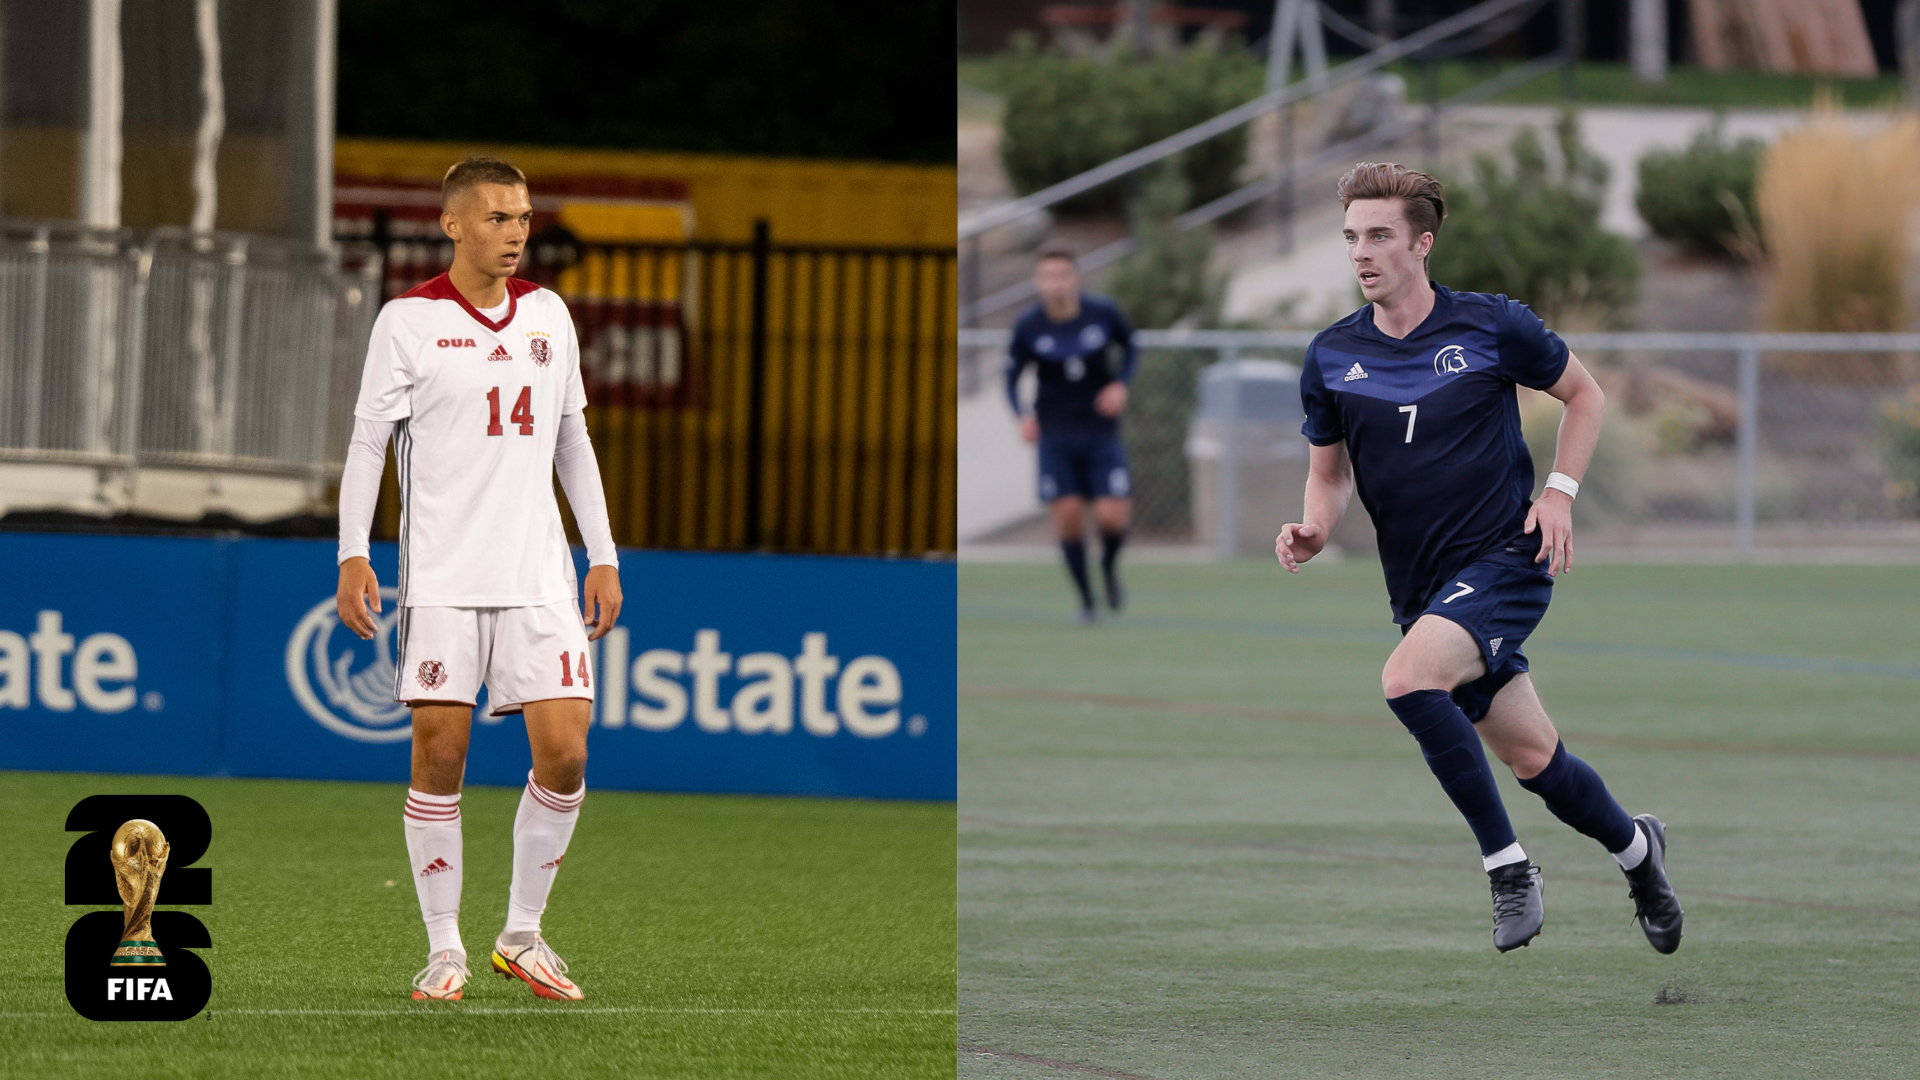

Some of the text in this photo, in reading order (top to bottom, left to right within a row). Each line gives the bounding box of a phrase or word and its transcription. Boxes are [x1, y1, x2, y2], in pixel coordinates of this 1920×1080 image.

[437, 338, 477, 348] OUA
[1344, 372, 1369, 382] adidas
[487, 386, 534, 436] 14
[1398, 405, 1417, 444] 7
[1442, 581, 1475, 604] 7
[560, 650, 589, 687] 14
